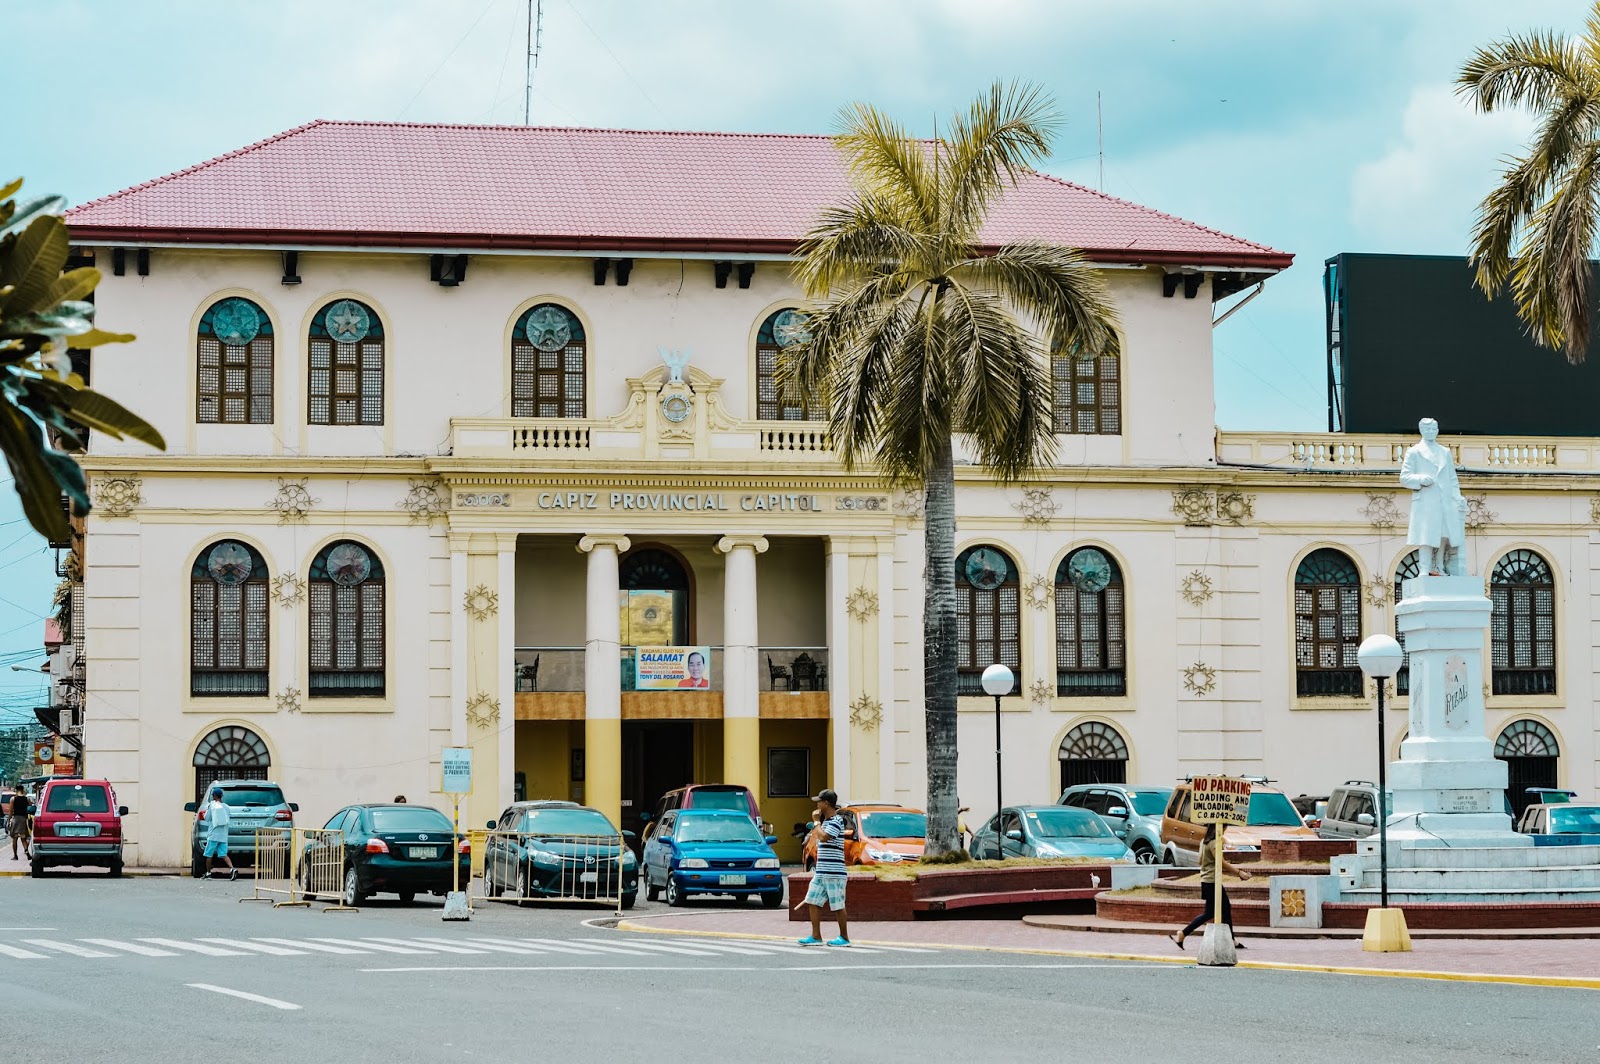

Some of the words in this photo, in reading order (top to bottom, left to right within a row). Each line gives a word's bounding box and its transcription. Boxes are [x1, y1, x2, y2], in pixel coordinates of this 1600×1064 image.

[538, 492, 598, 509] CAPIZ
[610, 492, 728, 511] PROVINCIAL
[741, 494, 822, 512] CAPITOL
[641, 654, 685, 662] SALAMAT
[1194, 778, 1207, 791] NO
[1211, 779, 1251, 796] PARKING
[1194, 793, 1231, 802] LOADING
[1235, 796, 1249, 805] AND
[1194, 803, 1234, 811] UNLOADING
